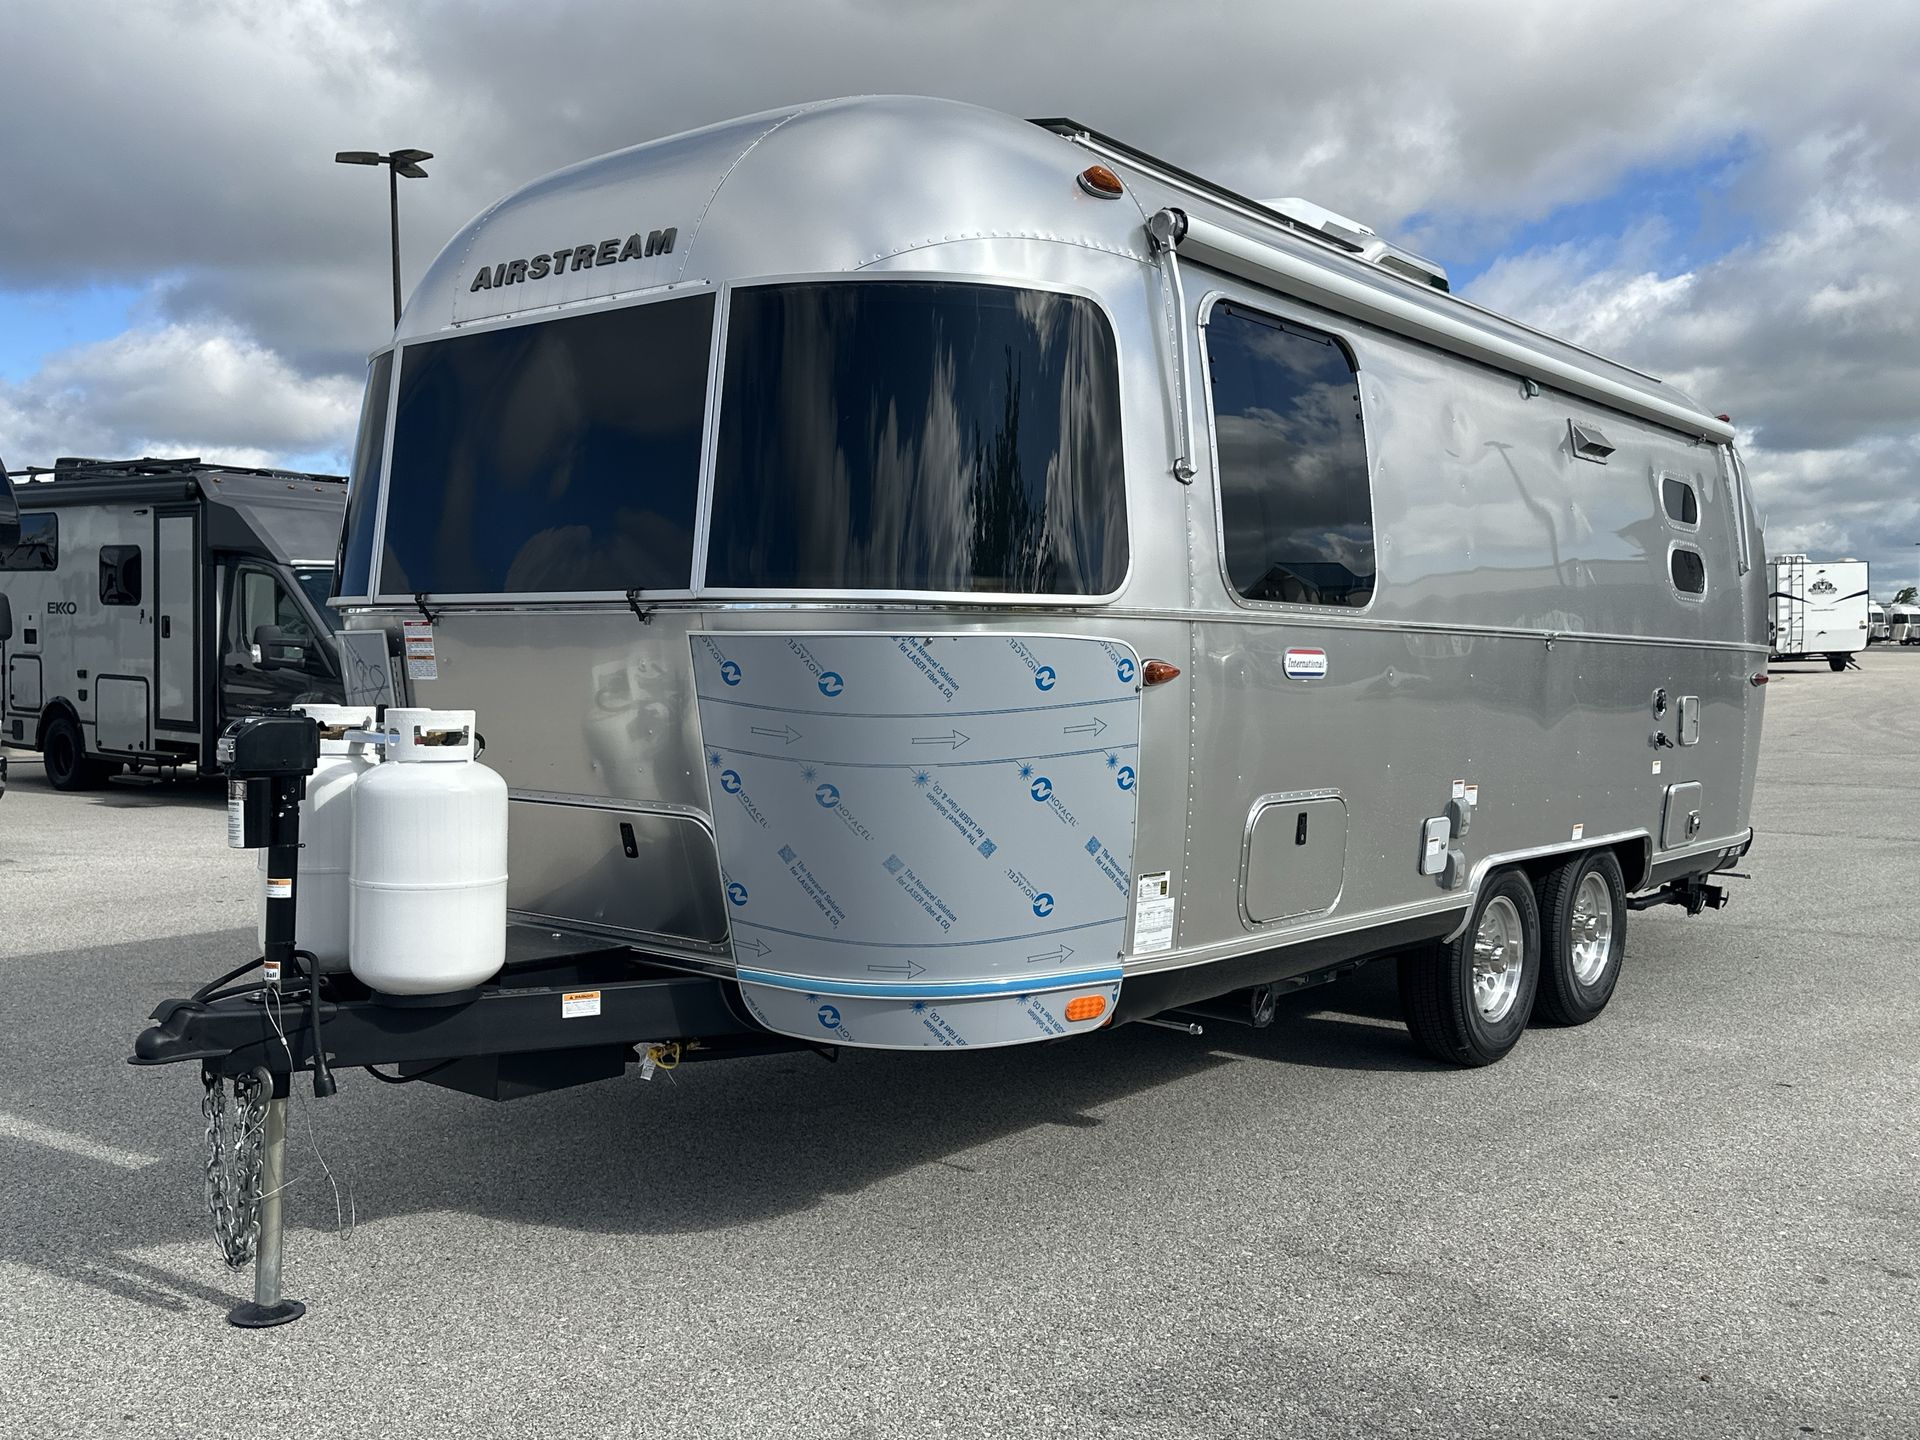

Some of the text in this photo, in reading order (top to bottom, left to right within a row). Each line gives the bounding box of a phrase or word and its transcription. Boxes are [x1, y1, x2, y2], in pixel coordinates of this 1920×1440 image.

[470, 227, 677, 292] AIRSTREAM
[47, 602, 77, 615] EKKO
[898, 641, 909, 653] for
[906, 650, 926, 671] LASER
[924, 668, 940, 685] Fiber
[937, 682, 945, 690] &
[916, 645, 939, 669] Novacel
[937, 666, 960, 690] Solution
[925, 792, 977, 845] The Novacel Solution
[945, 797, 960, 813] Fiber
[958, 810, 977, 830] LASER
[974, 827, 984, 837] for
[789, 866, 799, 876] for
[795, 875, 815, 895] LASER
[811, 894, 827, 911] Fiber
[796, 860, 847, 919] The Novacel Solution
[1100, 863, 1116, 880] LASER
[896, 875, 907, 887] for
[904, 883, 924, 904] LASER
[921, 900, 937, 917] Fiber
[904, 868, 957, 922] The Novacel Solution
[922, 1018, 945, 1042] Solution
[942, 1024, 957, 1040] Fiber
